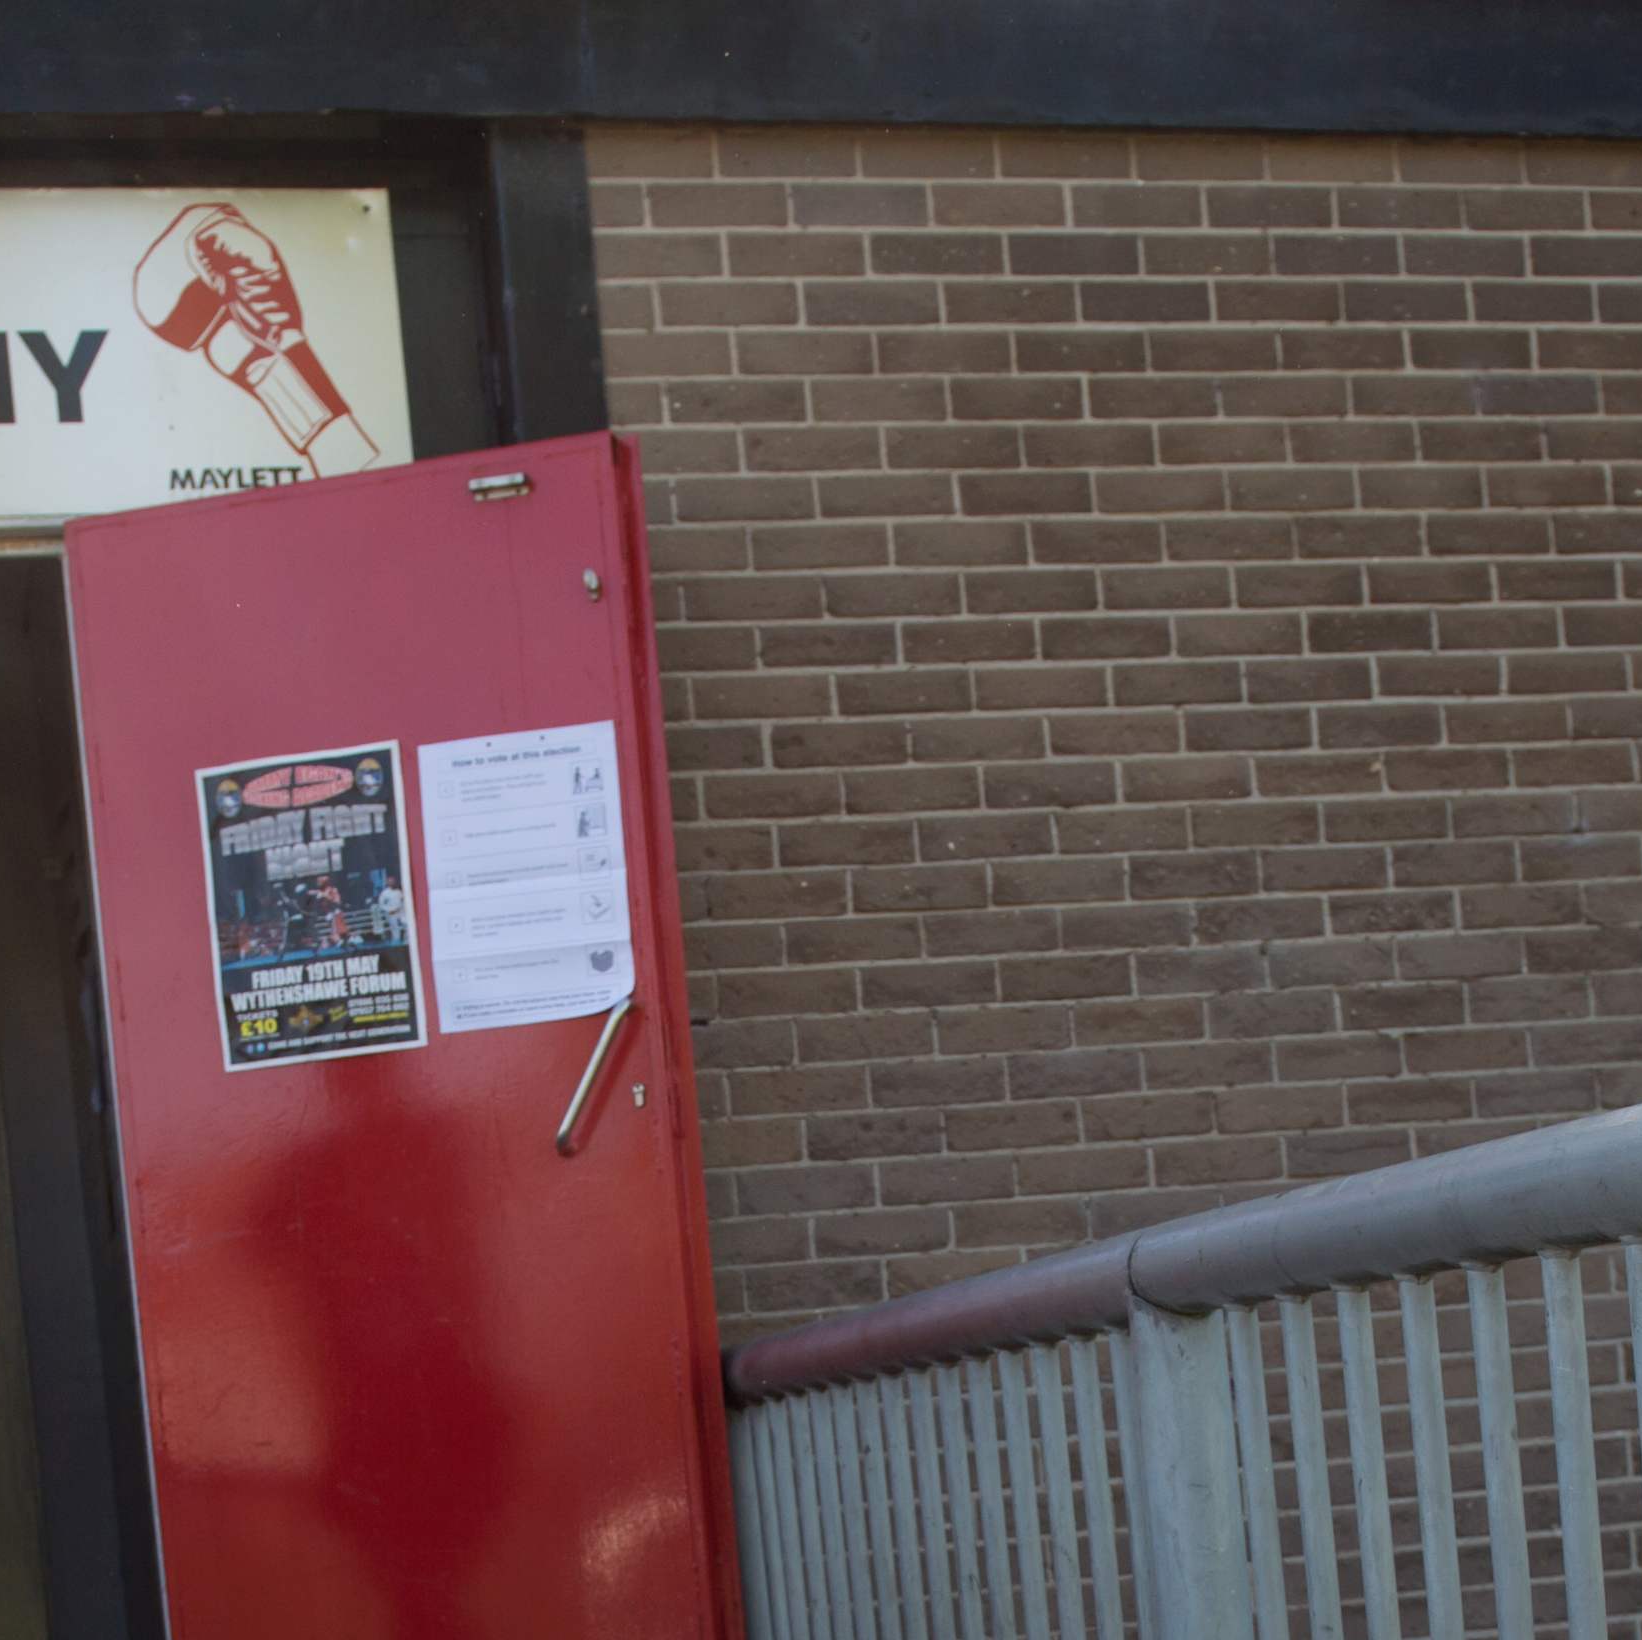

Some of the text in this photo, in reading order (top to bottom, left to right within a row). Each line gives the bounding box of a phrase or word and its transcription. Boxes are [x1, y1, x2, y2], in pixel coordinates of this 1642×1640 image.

[170, 466, 302, 490] MAYLETT
[220, 804, 388, 857] FRIDAY FIGHT
[251, 953, 380, 990] FRIDAY 19TH MAY
[230, 978, 349, 1012] WYTHENSHAWE
[349, 971, 407, 996] FORUM
[239, 1017, 278, 1038] £10
